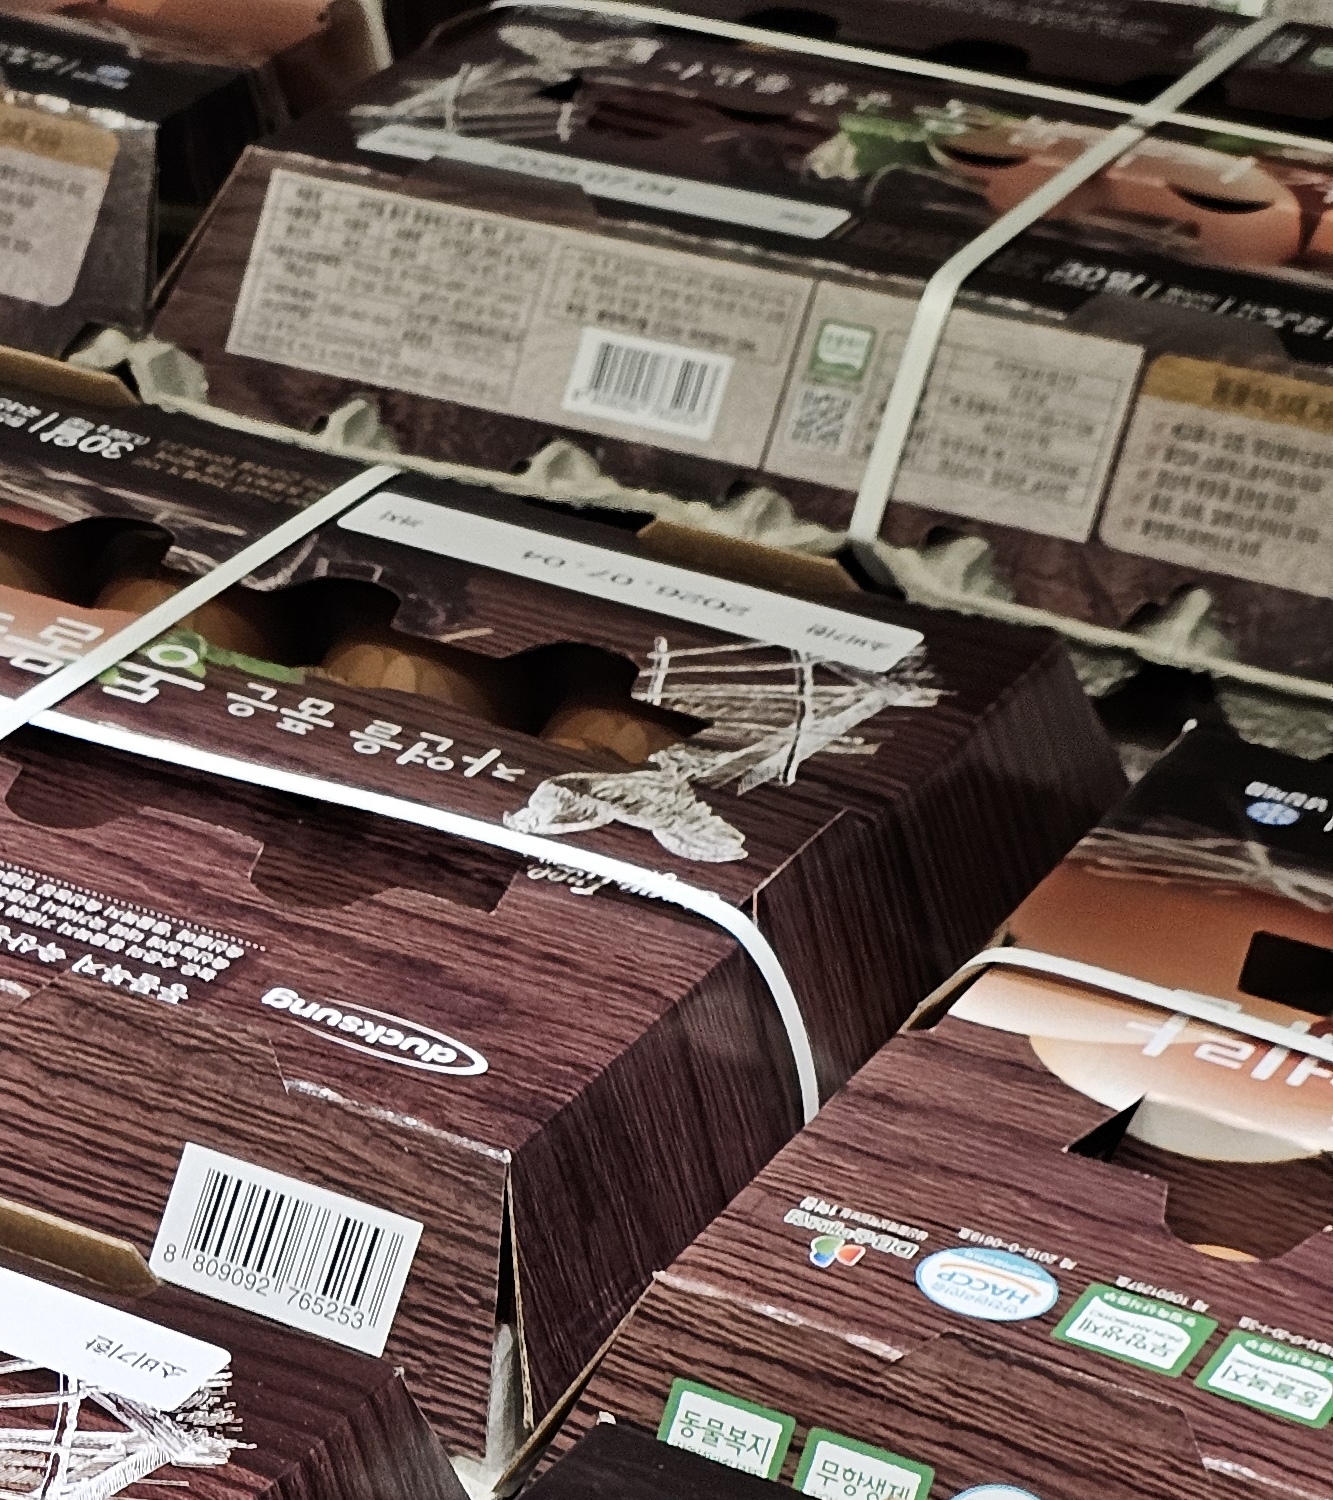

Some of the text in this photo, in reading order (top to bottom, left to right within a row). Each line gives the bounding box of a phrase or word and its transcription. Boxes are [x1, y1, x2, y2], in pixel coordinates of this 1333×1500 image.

[226, 680, 526, 786] 자연을 품은
[261, 987, 458, 1069] ducksung
[162, 1243, 365, 1331] 8 809092 765253
[938, 1269, 1031, 1304] HACCP
[676, 1409, 773, 1466] 동물복지
